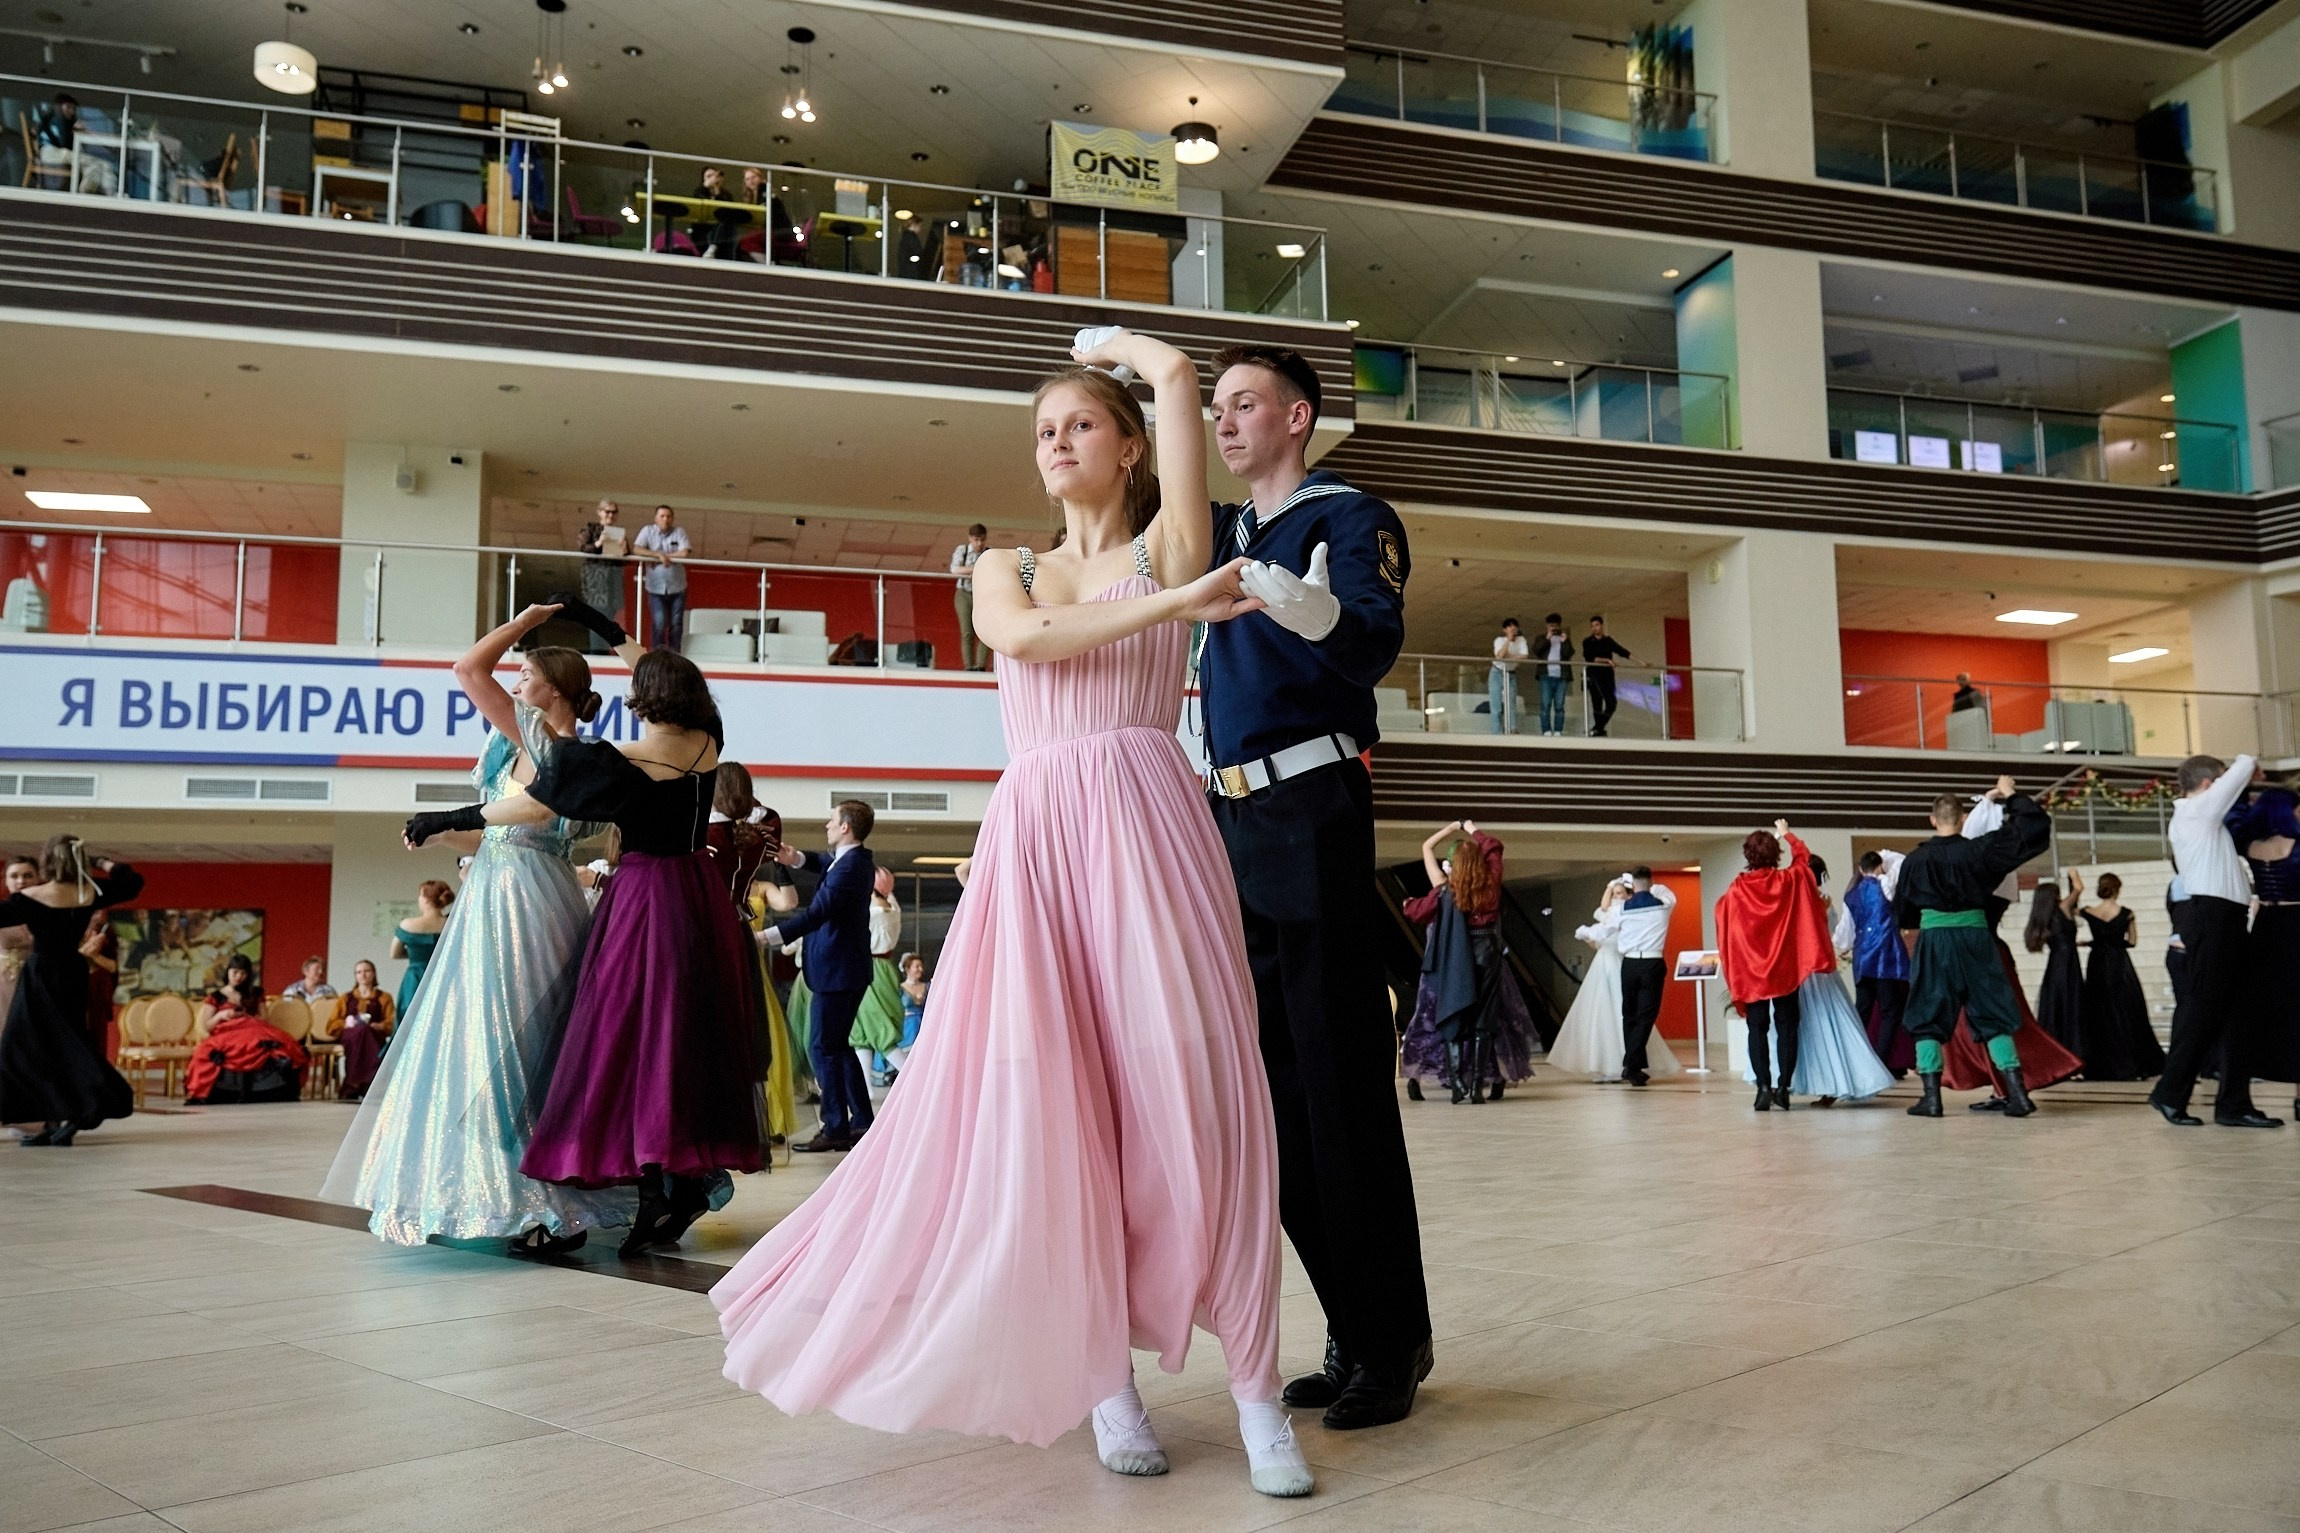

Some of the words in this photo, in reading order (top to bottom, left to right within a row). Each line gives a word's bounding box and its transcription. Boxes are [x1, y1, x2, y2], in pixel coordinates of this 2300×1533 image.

[1073, 148, 1160, 182] ONE
[1075, 173, 1119, 187] COFFEE
[58, 678, 95, 727] Я
[119, 679, 424, 736] ВЫБИРАЮ
